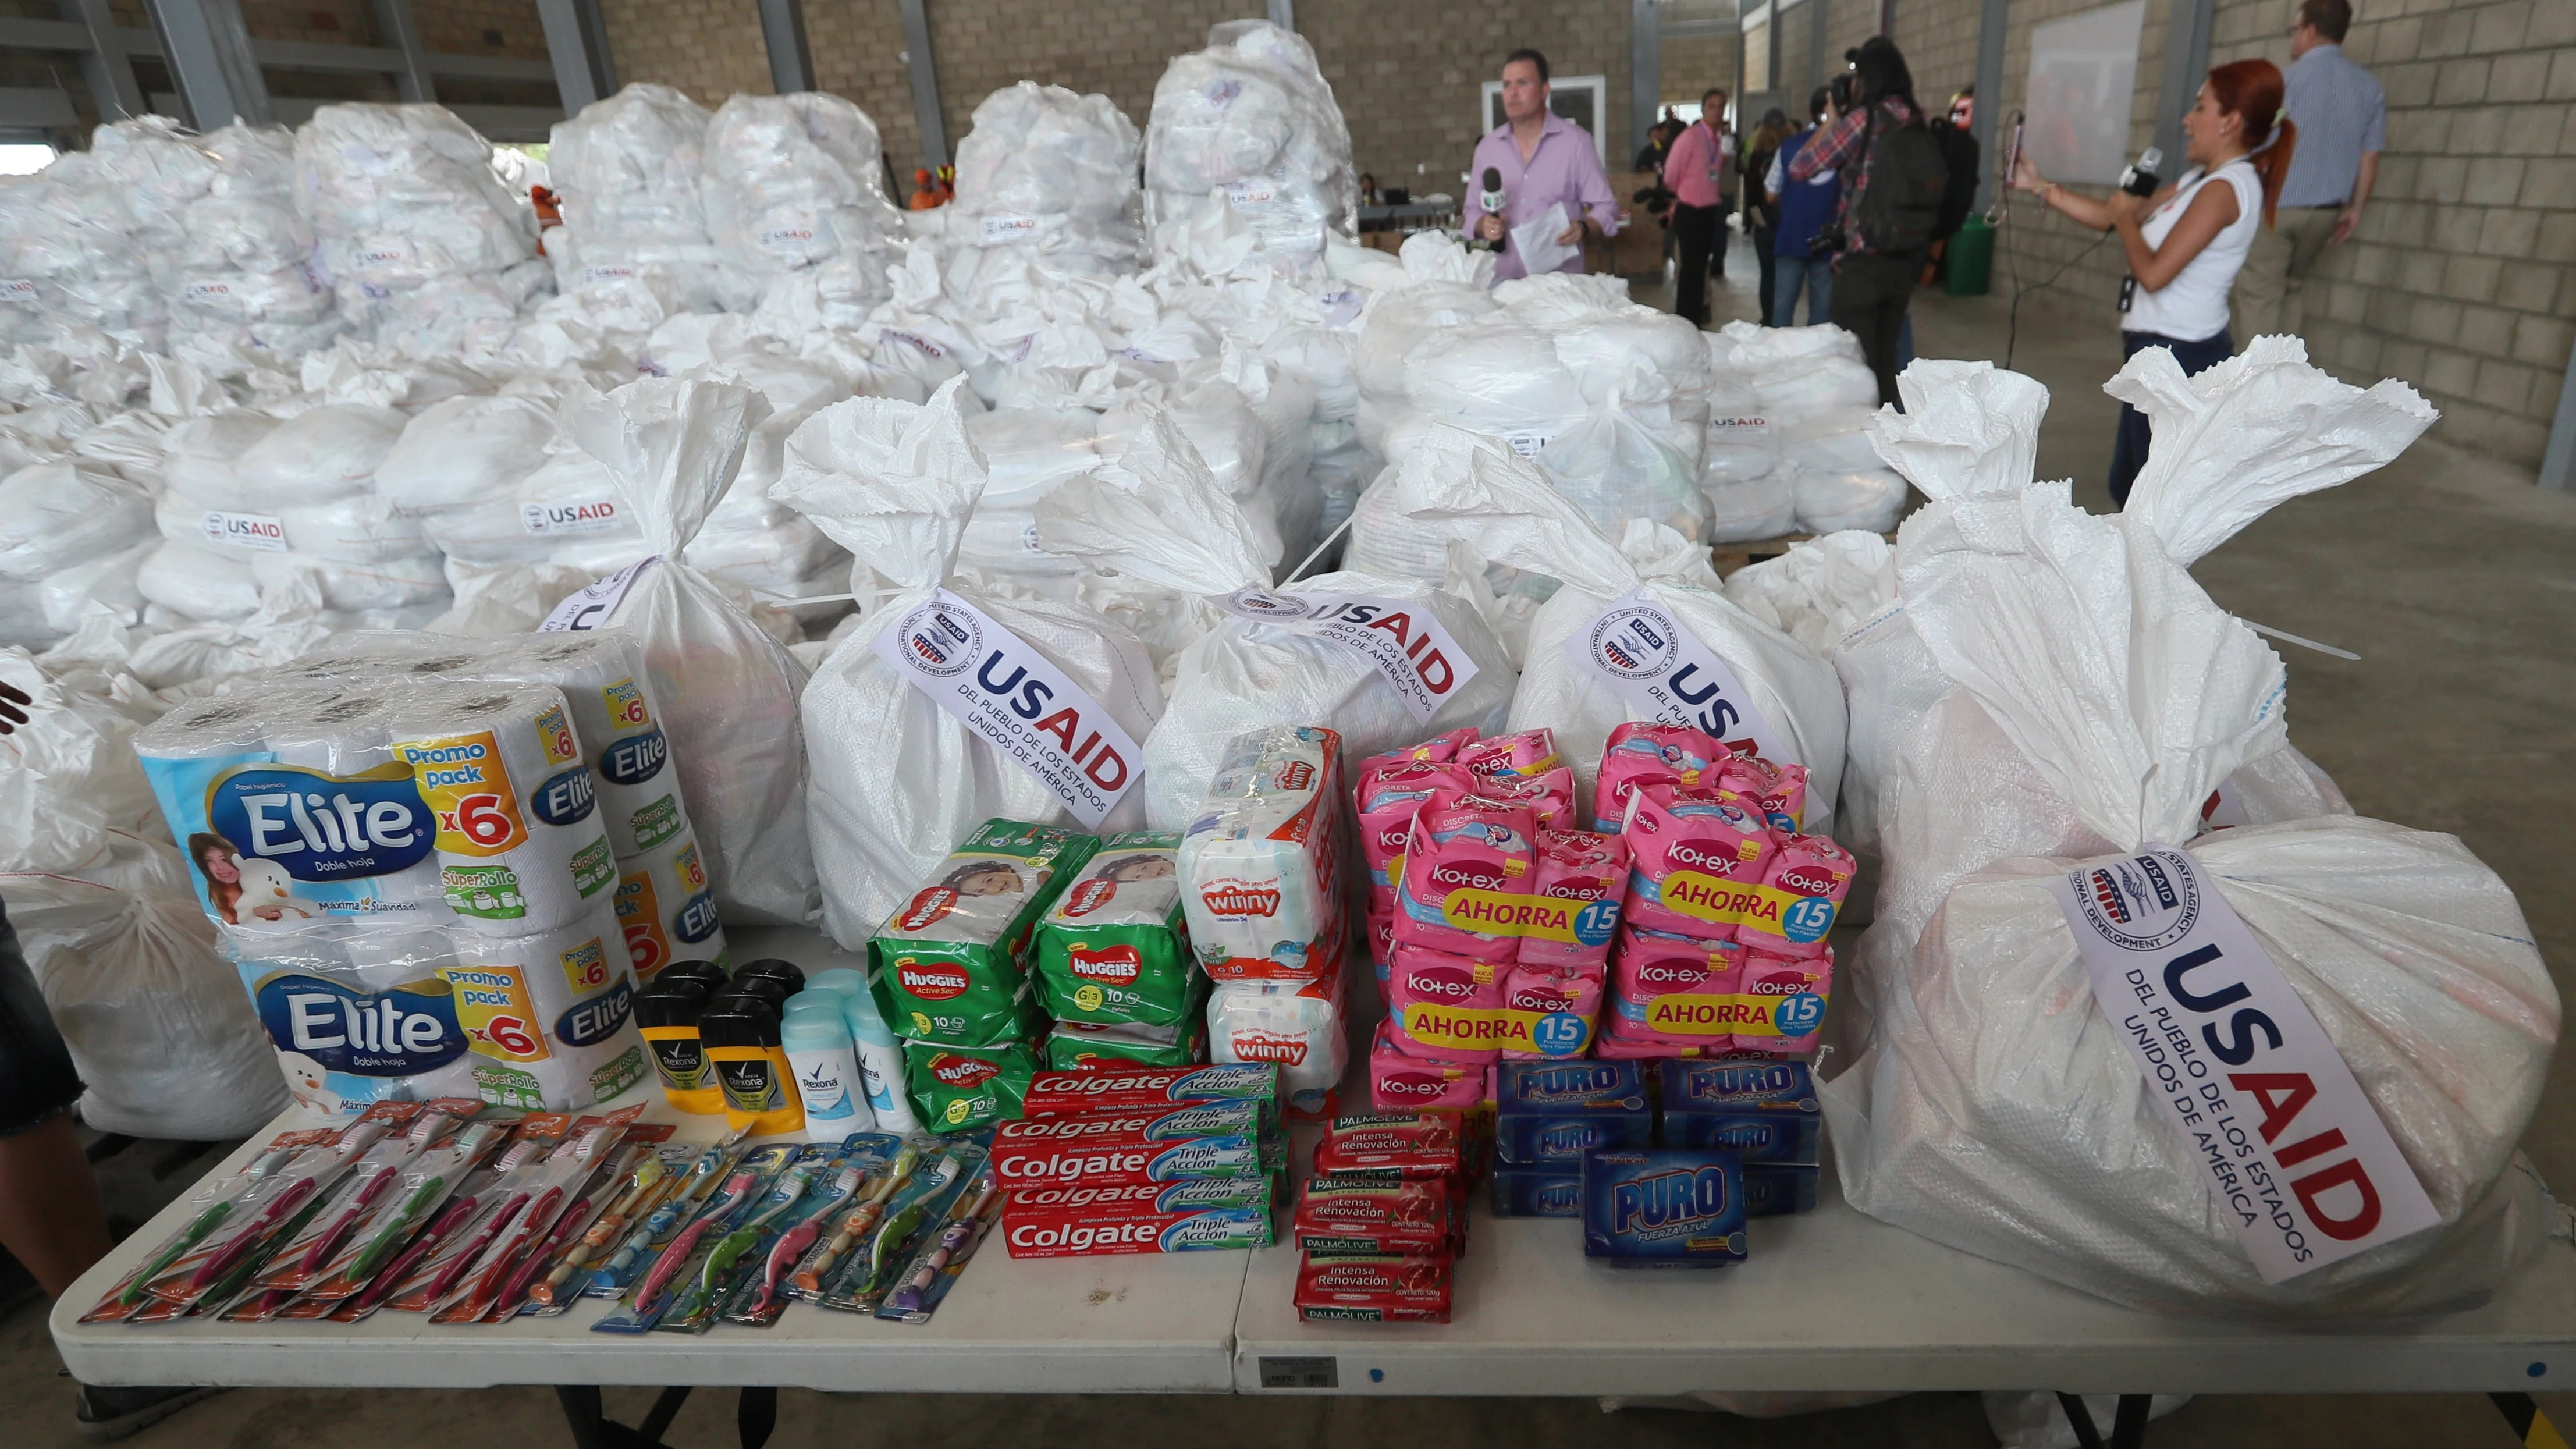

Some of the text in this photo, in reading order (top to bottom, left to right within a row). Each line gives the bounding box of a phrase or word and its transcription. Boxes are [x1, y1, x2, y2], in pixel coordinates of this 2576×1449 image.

[773, 230, 812, 240] USAID
[999, 218, 1035, 230] USAID
[1715, 417, 1765, 426] USAID
[549, 502, 614, 521] USAID
[228, 519, 280, 539] USAID
[939, 615, 967, 641] USAID
[952, 606, 973, 623] STATES
[971, 621, 980, 651] AGENCY
[1619, 609, 1678, 661] UNITED STATES AGENCY
[1634, 621, 1660, 647] USAID
[900, 617, 970, 676] INTERNATIONAL DEVELOPMENT
[1307, 603, 1454, 694] USAID
[1591, 619, 1662, 679] INTERNATIONAL DEVELOPMENT
[1349, 638, 1369, 651] DE
[1367, 649, 1409, 698] AMÉRICA
[1358, 630, 1375, 641] DE
[1376, 638, 1398, 658] LOS
[1398, 654, 1433, 712] ESTADOS
[1647, 686, 1669, 706] DEL
[977, 649, 1128, 792] USAID
[404, 743, 487, 767] Promo
[614, 734, 667, 778] Elite
[958, 684, 1106, 813] DEL PUEBLO DE LOS ESTADOS
[968, 711, 1076, 806] UNIDOS DE AMÉRICA
[425, 765, 486, 790] pack
[1287, 761, 1309, 790] winny
[548, 771, 594, 818] Elite
[1372, 784, 1411, 795] DISCRETA
[240, 790, 414, 857] Elite
[439, 793, 511, 848] x6
[1442, 814, 1485, 827] DISCRETA
[315, 857, 375, 872] Doble hoja
[1667, 840, 1739, 875] kotex
[440, 871, 518, 890] SúperRollo
[1432, 864, 1505, 891] kotex
[1505, 865, 1525, 874] NUEVA
[2144, 859, 2173, 903] USAID
[1545, 883, 1604, 901] kotex
[1779, 869, 1838, 895] kotex
[2168, 854, 2197, 933] STATES AGENCY
[318, 899, 417, 912] Máxima Suavidad
[1071, 881, 1108, 913] HUGGIES
[1207, 885, 1277, 914] winny
[1669, 880, 1778, 921] AHORRA
[907, 890, 951, 928] HUGGIES
[1451, 898, 1569, 929] AHORRA
[1584, 906, 1620, 929] 15
[1794, 901, 1831, 928] 15
[2087, 907, 2161, 949] DEVELOPMENT
[446, 969, 514, 988] Promo
[903, 970, 965, 988] HUGGIES
[1074, 958, 1136, 977] HUGGIES
[1230, 965, 1243, 974] 10
[1639, 964, 1711, 983] kotex
[916, 987, 940, 995] Active
[1107, 990, 1123, 1003] 10
[1408, 973, 1477, 997] kotex
[1751, 980, 1811, 995] kotex
[463, 989, 513, 1007] pack
[1513, 992, 1572, 1011] kotex
[1782, 997, 1819, 1021] 15
[285, 994, 444, 1053] Elite
[571, 990, 628, 1040] Elite
[933, 1016, 948, 1028] 10
[1654, 1004, 1770, 1025] AHORRA
[470, 1015, 538, 1054] x6
[1414, 1013, 1528, 1040] AHORRA
[1541, 1017, 1579, 1042] 15
[353, 1054, 407, 1068] Doble hoja
[663, 1056, 698, 1066] Rexona
[1235, 1039, 1307, 1064] winny
[471, 1068, 541, 1091] SúperRollo
[729, 1077, 763, 1086] Rexona
[802, 1078, 837, 1088] Rexona
[1034, 1074, 1170, 1095] Colgate
[1181, 1079, 1239, 1089] Acción
[1200, 1068, 1246, 1081] Triple
[1517, 1064, 1621, 1100] PURO
[1690, 1064, 1795, 1099] PURO
[1380, 1077, 1449, 1096] kotex
[2163, 942, 2382, 1242] USAID
[1538, 1095, 1577, 1104] FUERZA
[1001, 1117, 1147, 1139] Colgate
[1339, 1115, 1413, 1127] PALMOLIVE
[2124, 968, 2315, 1265] DEL PUEBLO DE LOS ESTADOS
[2124, 1014, 2259, 1230] UNIDOS DE AMÉRICA
[1341, 1139, 1406, 1149] Renovación
[1539, 1124, 1599, 1155] PURO
[1167, 1157, 1216, 1170] Acción
[1179, 1145, 1219, 1160] Triple
[1000, 1152, 1145, 1181] Colgate
[1014, 1185, 1159, 1208] Colgate
[1316, 1180, 1395, 1190] PALMOLIVE
[1612, 1166, 1727, 1235] PURO
[1178, 1229, 1228, 1241] Acción
[1191, 1218, 1231, 1230] Triple
[1637, 1221, 1710, 1242] FUERZA AZUL
[1012, 1224, 1156, 1250] Colgate
[1307, 1240, 1372, 1249] PALMOLIVE
[902, 1258, 926, 1287] Suaves
[1318, 1276, 1388, 1286] Renovación
[1331, 1267, 1375, 1275] Intensa
[1310, 1311, 1376, 1320] PALMOLIVE
